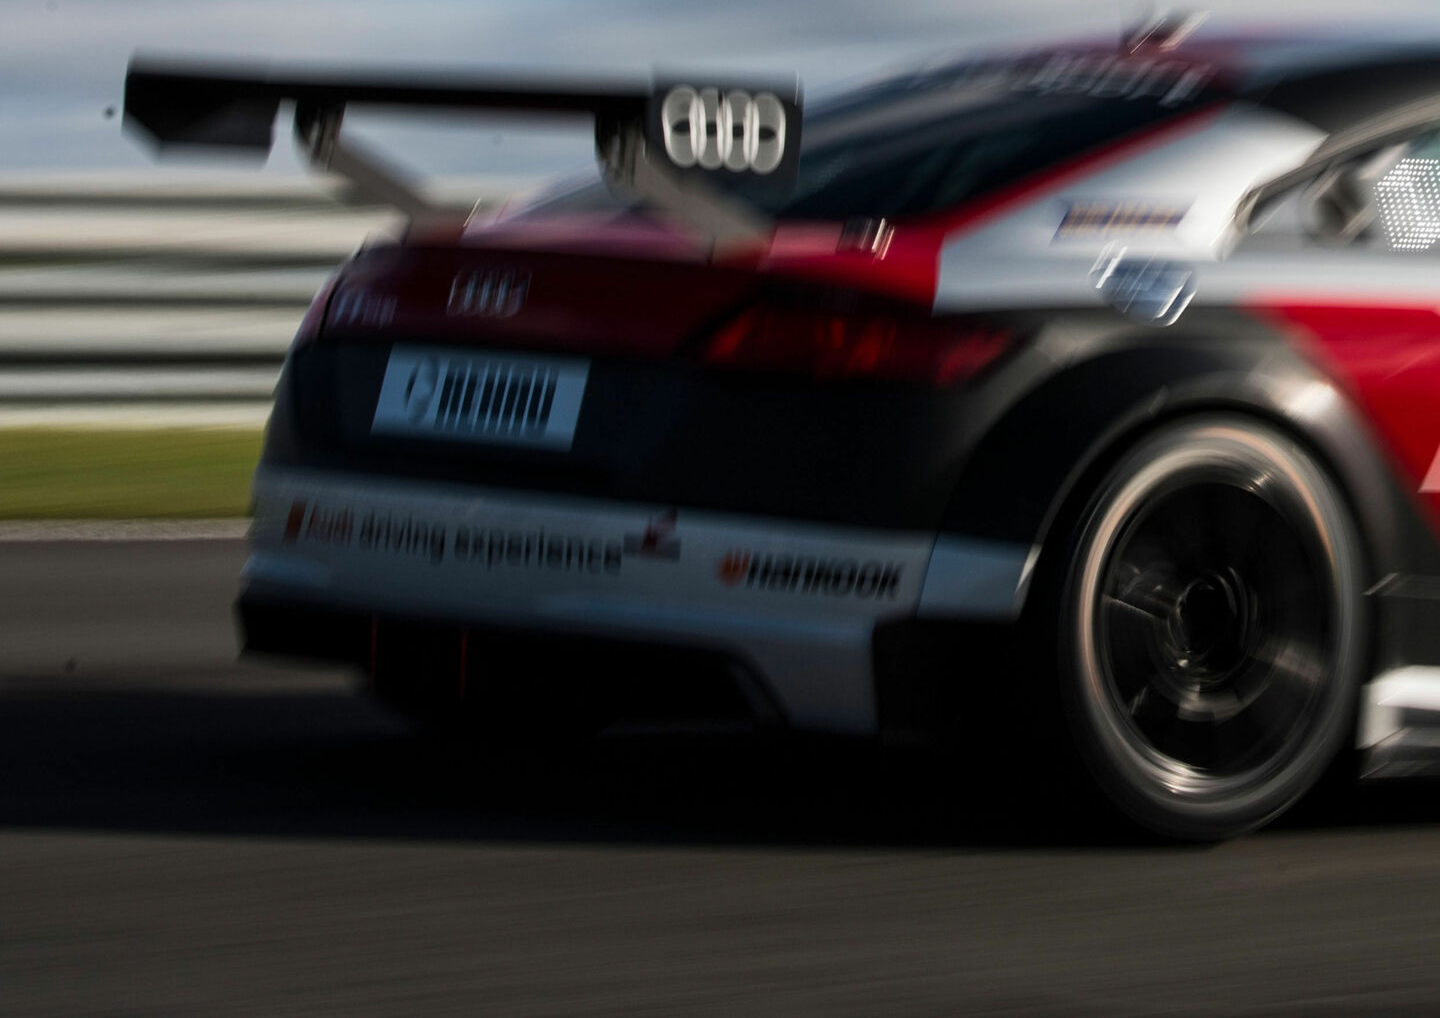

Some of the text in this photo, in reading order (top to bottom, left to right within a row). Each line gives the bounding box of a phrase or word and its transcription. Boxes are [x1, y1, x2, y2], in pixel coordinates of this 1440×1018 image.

[306, 500, 622, 576] Audi driving experience
